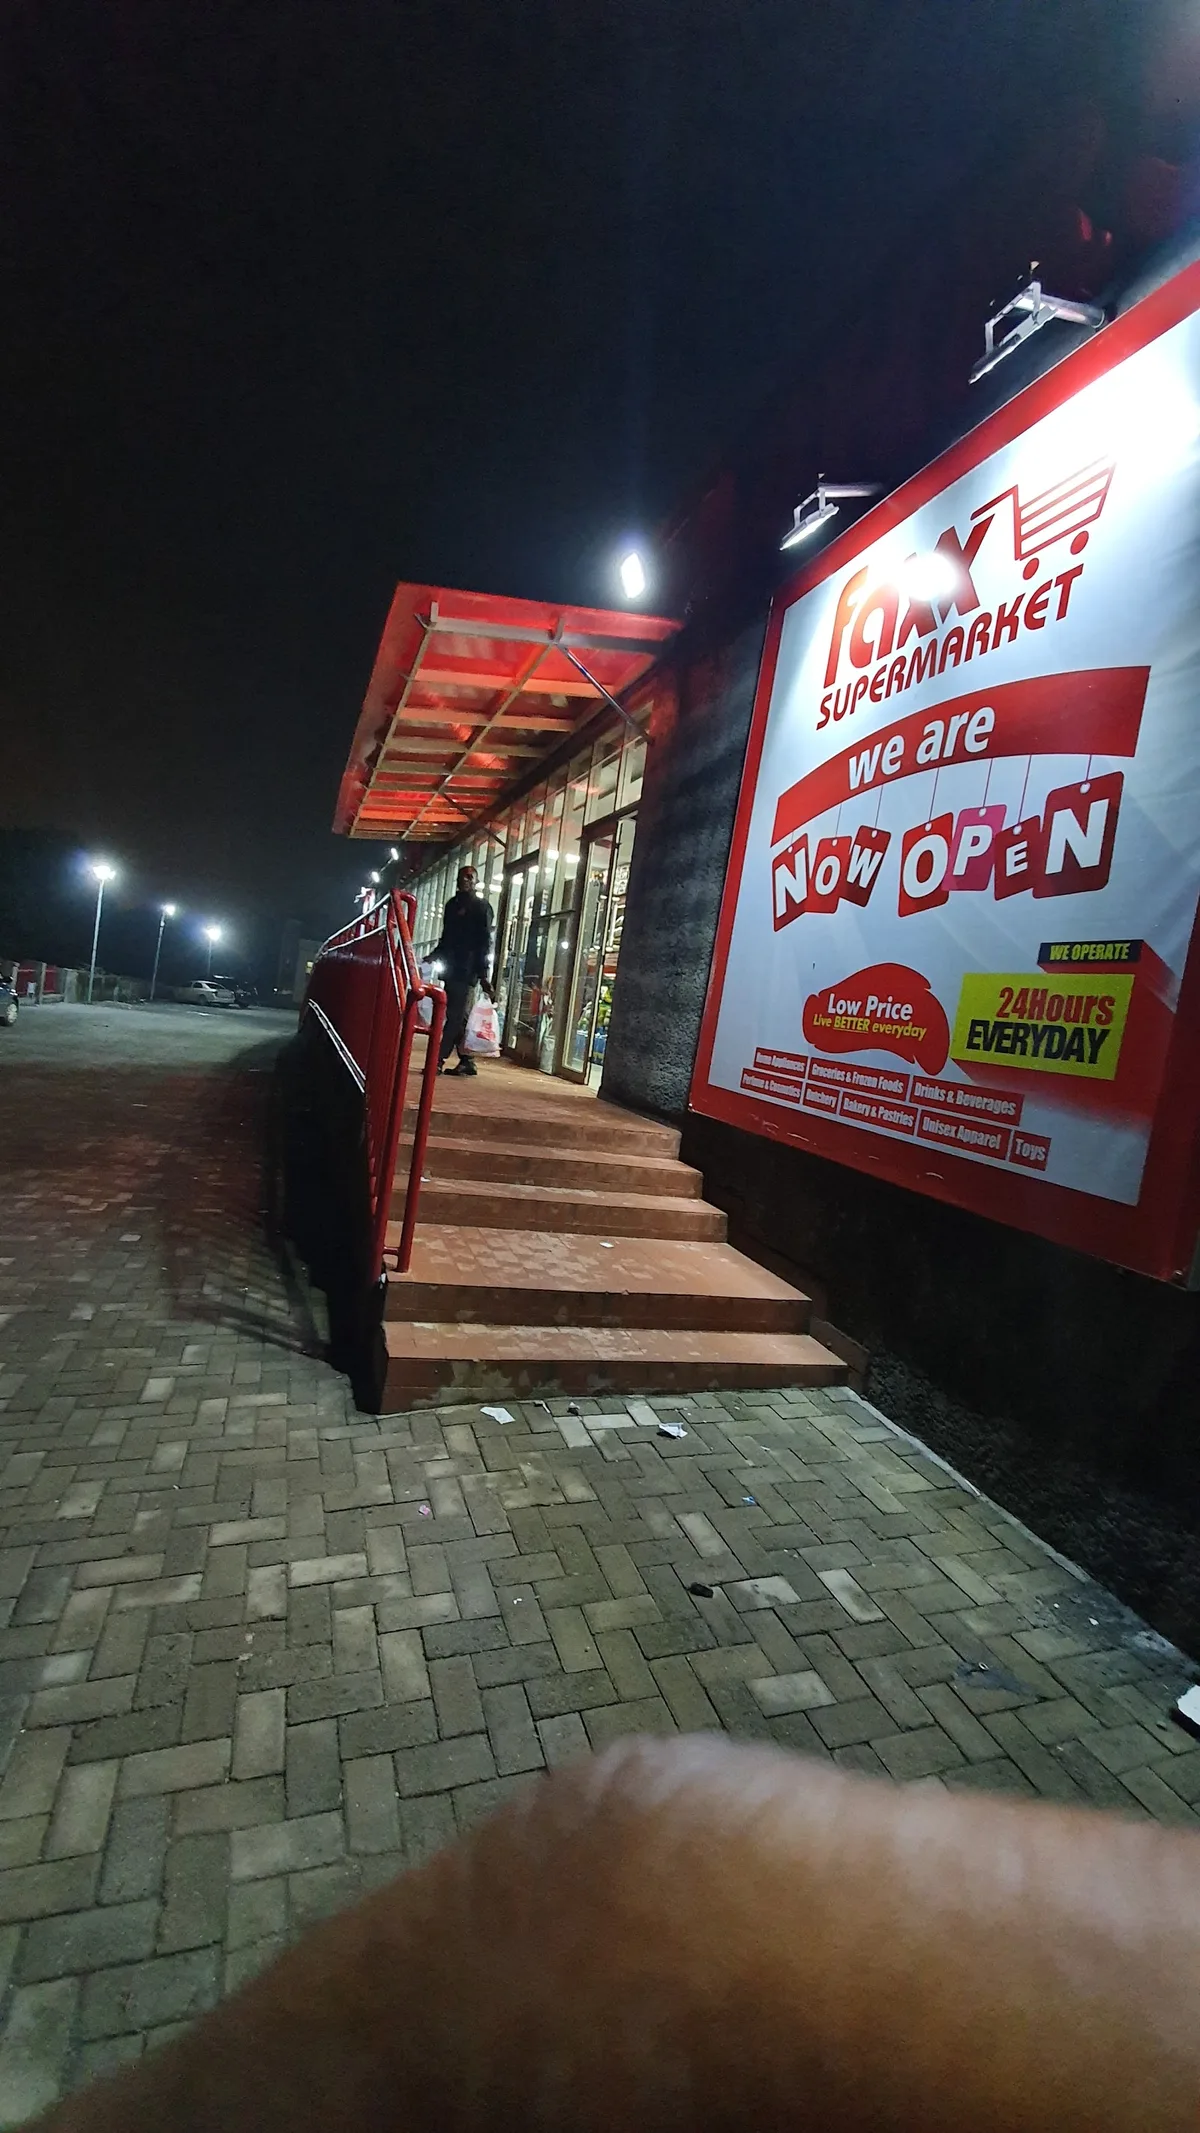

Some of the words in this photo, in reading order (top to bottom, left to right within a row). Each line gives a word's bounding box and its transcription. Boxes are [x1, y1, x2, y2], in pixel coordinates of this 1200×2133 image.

[816, 563, 1084, 731] SUPERMARKET
[848, 735, 905, 789] we
[917, 706, 996, 761] are
[774, 846, 883, 919] NOW
[903, 799, 1110, 899] OPEN
[1050, 944, 1070, 961] WE
[1072, 943, 1130, 960] OPERATE
[828, 993, 862, 1016] Low
[865, 995, 913, 1020] Price
[996, 986, 1116, 1026] 24Hours
[813, 1014, 832, 1027] Live
[833, 1016, 870, 1032] BETTER
[872, 1021, 927, 1041] everyday
[966, 1019, 1111, 1064] EVERYDAY
[811, 1063, 845, 1081] Groceries
[845, 1073, 852, 1083] &
[852, 1071, 878, 1088] Frozen
[878, 1076, 904, 1094] Foods
[843, 1097, 871, 1117] Bakery
[871, 1106, 877, 1118] &
[878, 1106, 914, 1127] Pastries
[914, 1082, 946, 1102] Drinks
[947, 1090, 954, 1103] &
[955, 1090, 1017, 1116] Beverages
[922, 1116, 957, 1138] Unisex
[957, 1125, 1002, 1150] Apparel
[1014, 1138, 1047, 1161] Toys
